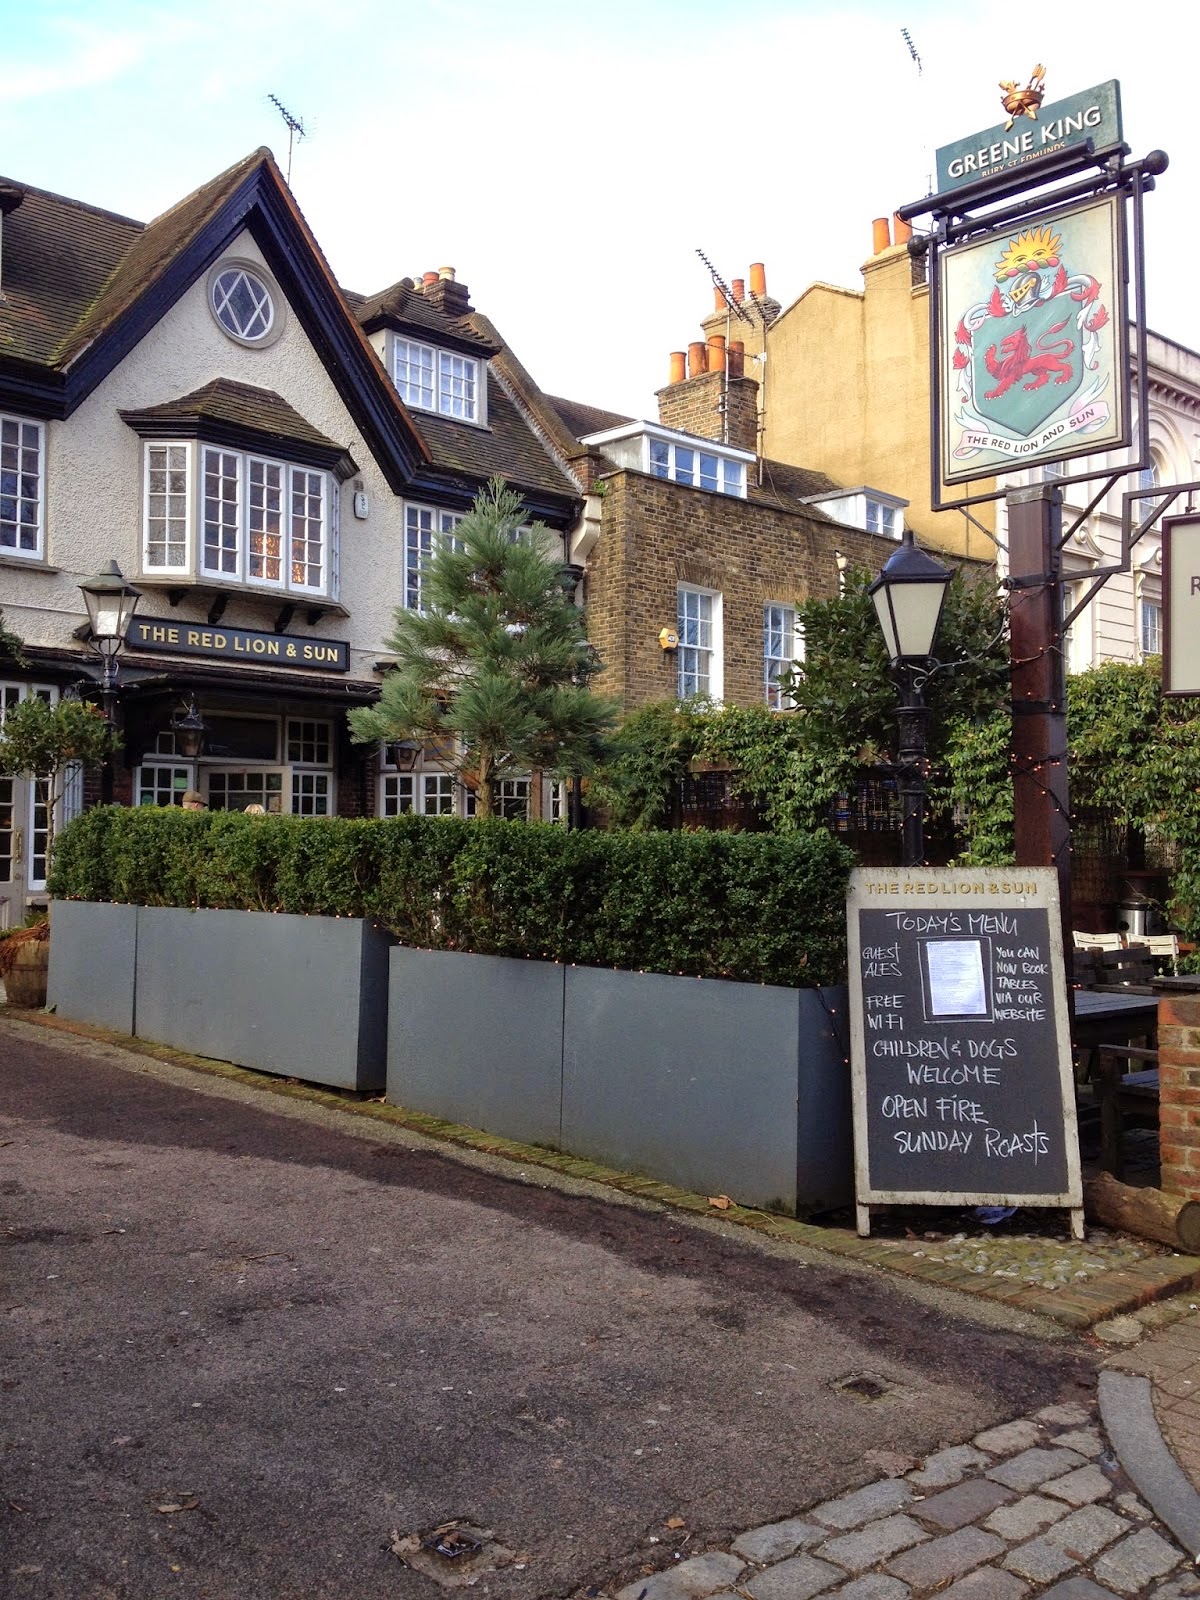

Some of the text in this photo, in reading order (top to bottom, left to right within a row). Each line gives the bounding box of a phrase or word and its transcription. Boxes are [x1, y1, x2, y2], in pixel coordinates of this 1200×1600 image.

[948, 105, 1102, 178] GREENE KING
[967, 408, 1095, 453] THE RED LION AND SUN
[139, 624, 338, 662] THE RED LION & SUN
[865, 882, 899, 895] THE
[904, 882, 939, 895] RED
[942, 882, 985, 895] LION
[885, 911, 1018, 936] TODAY'S MENU
[862, 942, 901, 963] GUEST
[1017, 946, 1040, 960] CAN
[864, 962, 903, 978] ALES
[996, 961, 1049, 975] NOW BOOK
[996, 976, 1038, 990] TABLES
[866, 995, 906, 1009] FREE
[995, 992, 1044, 1005] VIA OUR
[873, 1037, 950, 1060] CHILDREN
[968, 1038, 1018, 1060] DOGS
[907, 1063, 1001, 1086] WELCOME
[881, 1094, 928, 1118] OPEN
[893, 1129, 973, 1155] SUNDAY
